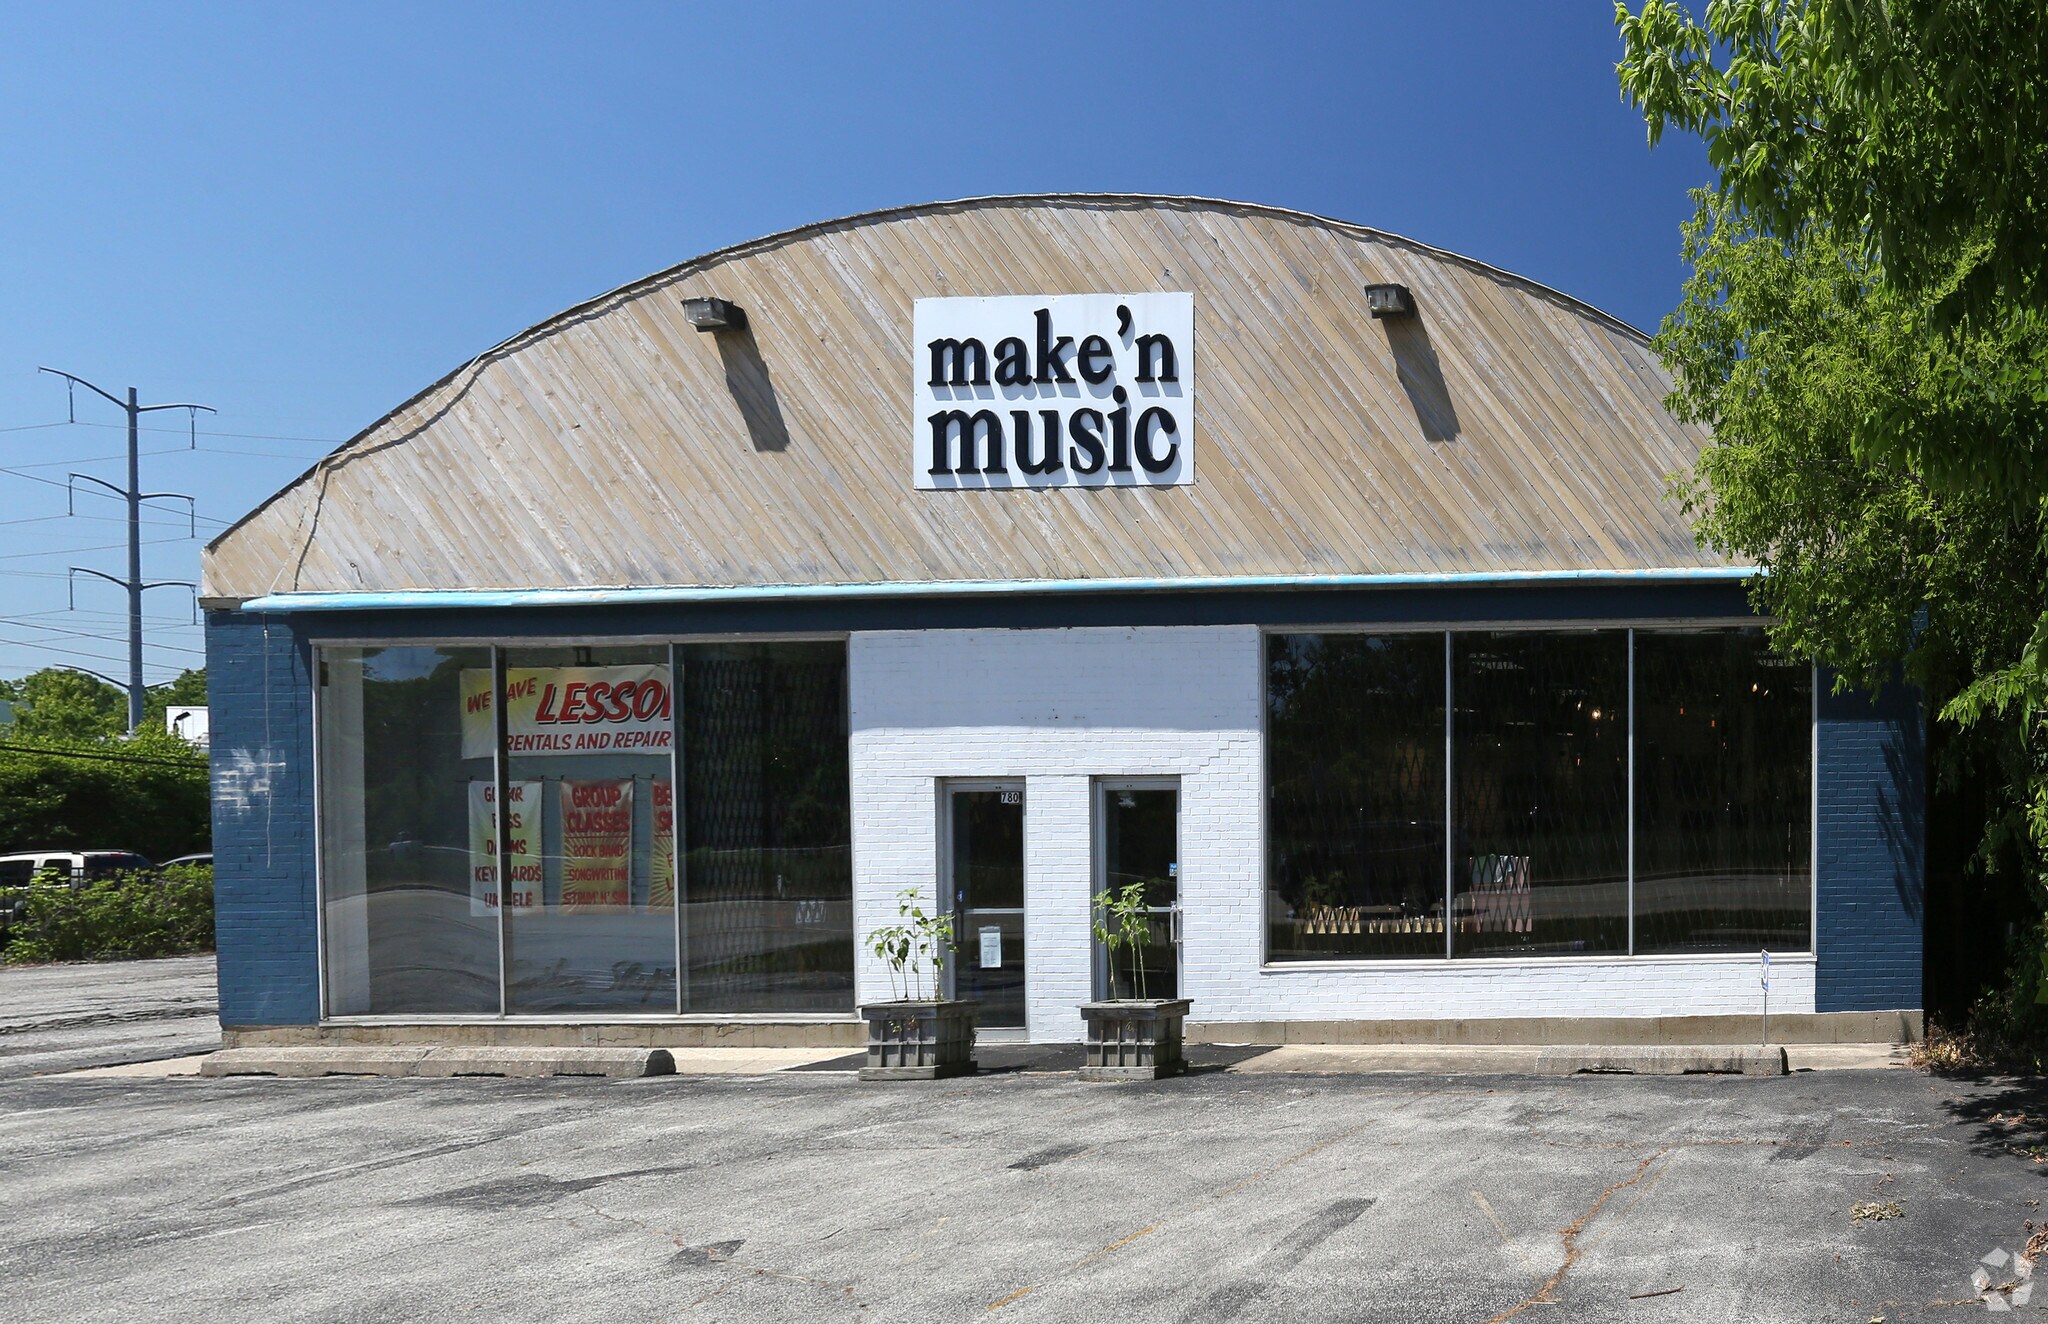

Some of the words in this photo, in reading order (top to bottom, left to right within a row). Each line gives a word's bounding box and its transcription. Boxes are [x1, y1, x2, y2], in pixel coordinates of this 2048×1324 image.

[927, 304, 1178, 386] make'n
[927, 385, 1177, 476] music
[467, 690, 492, 714] WE
[506, 677, 537, 702] AVE
[507, 732, 572, 751] RENTALS
[575, 732, 611, 750] AND
[613, 730, 672, 748] REPAIR
[572, 786, 621, 807] GROUP
[1002, 792, 1018, 803] 780
[567, 811, 629, 832] CLASSES
[574, 845, 597, 857] ROCK
[475, 864, 542, 882] KEYARDS
